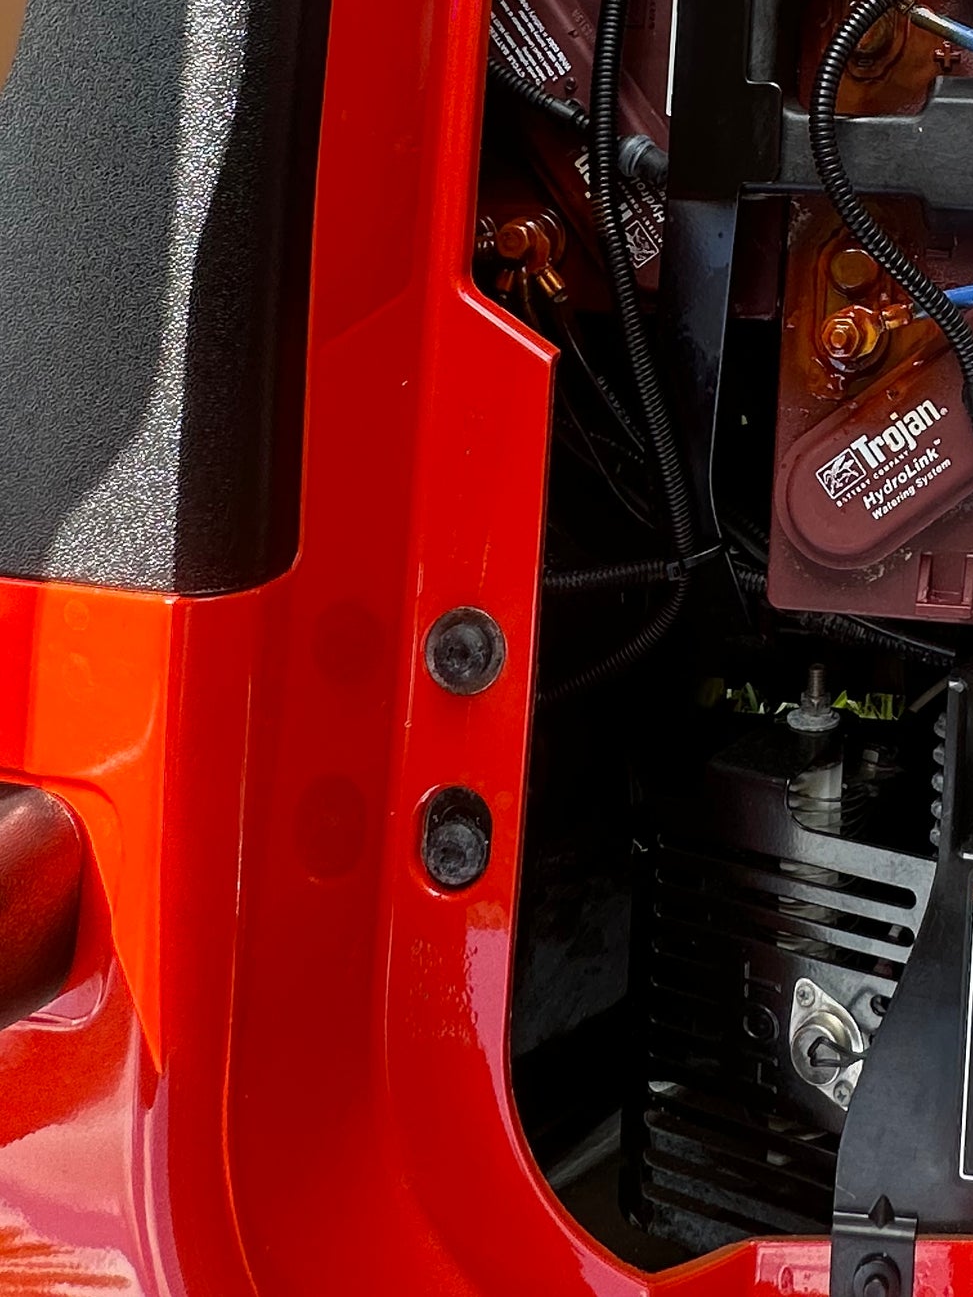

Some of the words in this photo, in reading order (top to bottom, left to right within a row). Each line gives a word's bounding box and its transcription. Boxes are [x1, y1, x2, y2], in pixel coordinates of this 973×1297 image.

[850, 400, 941, 469] Trojan
[836, 478, 870, 507] BATTERY
[873, 450, 908, 479] COMPANY
[863, 448, 939, 509] HydroLink
[872, 485, 916, 520] Watering
[916, 459, 951, 488] System
